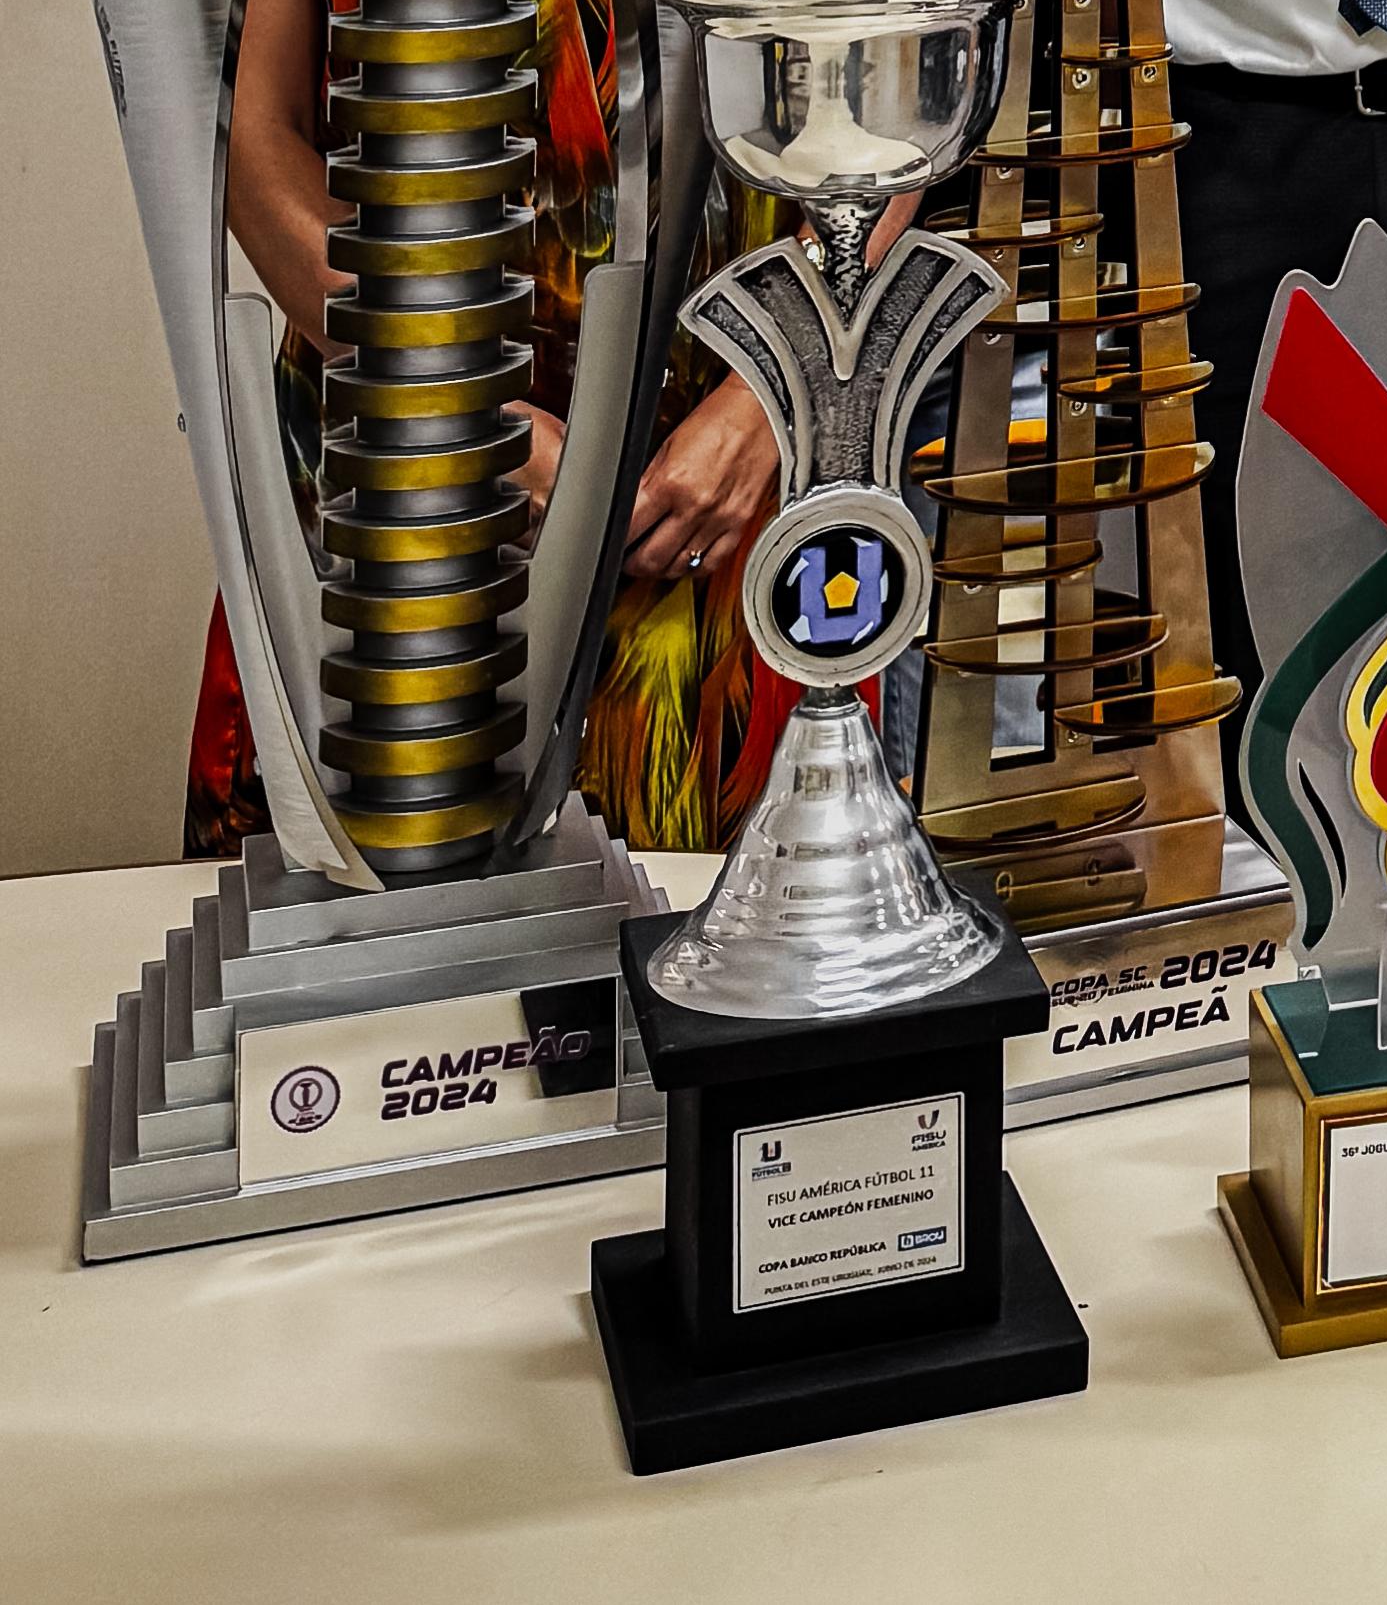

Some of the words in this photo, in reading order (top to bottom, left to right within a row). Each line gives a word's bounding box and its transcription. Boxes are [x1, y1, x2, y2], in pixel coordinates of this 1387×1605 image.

[1051, 973, 1109, 997] COPA
[1118, 965, 1148, 985] SC
[1160, 939, 1277, 990] 2024
[1052, 985, 1231, 1055] CAMPEÃ
[381, 1027, 592, 1088] CAMPEÃO
[381, 1078, 498, 1121] 2024
[767, 1190, 797, 1207] FISU
[800, 1180, 862, 1200] AMÉRICA
[865, 1168, 915, 1189] FÚTBOL
[920, 1165, 935, 1179] 11
[768, 1214, 796, 1229] VICE
[800, 1200, 864, 1223] CAMPEÓN
[867, 1189, 934, 1211] FEMENINO
[758, 1260, 788, 1274] COPA
[790, 1253, 828, 1268] BANCO
[830, 1241, 887, 1260] REPÚBLICA
